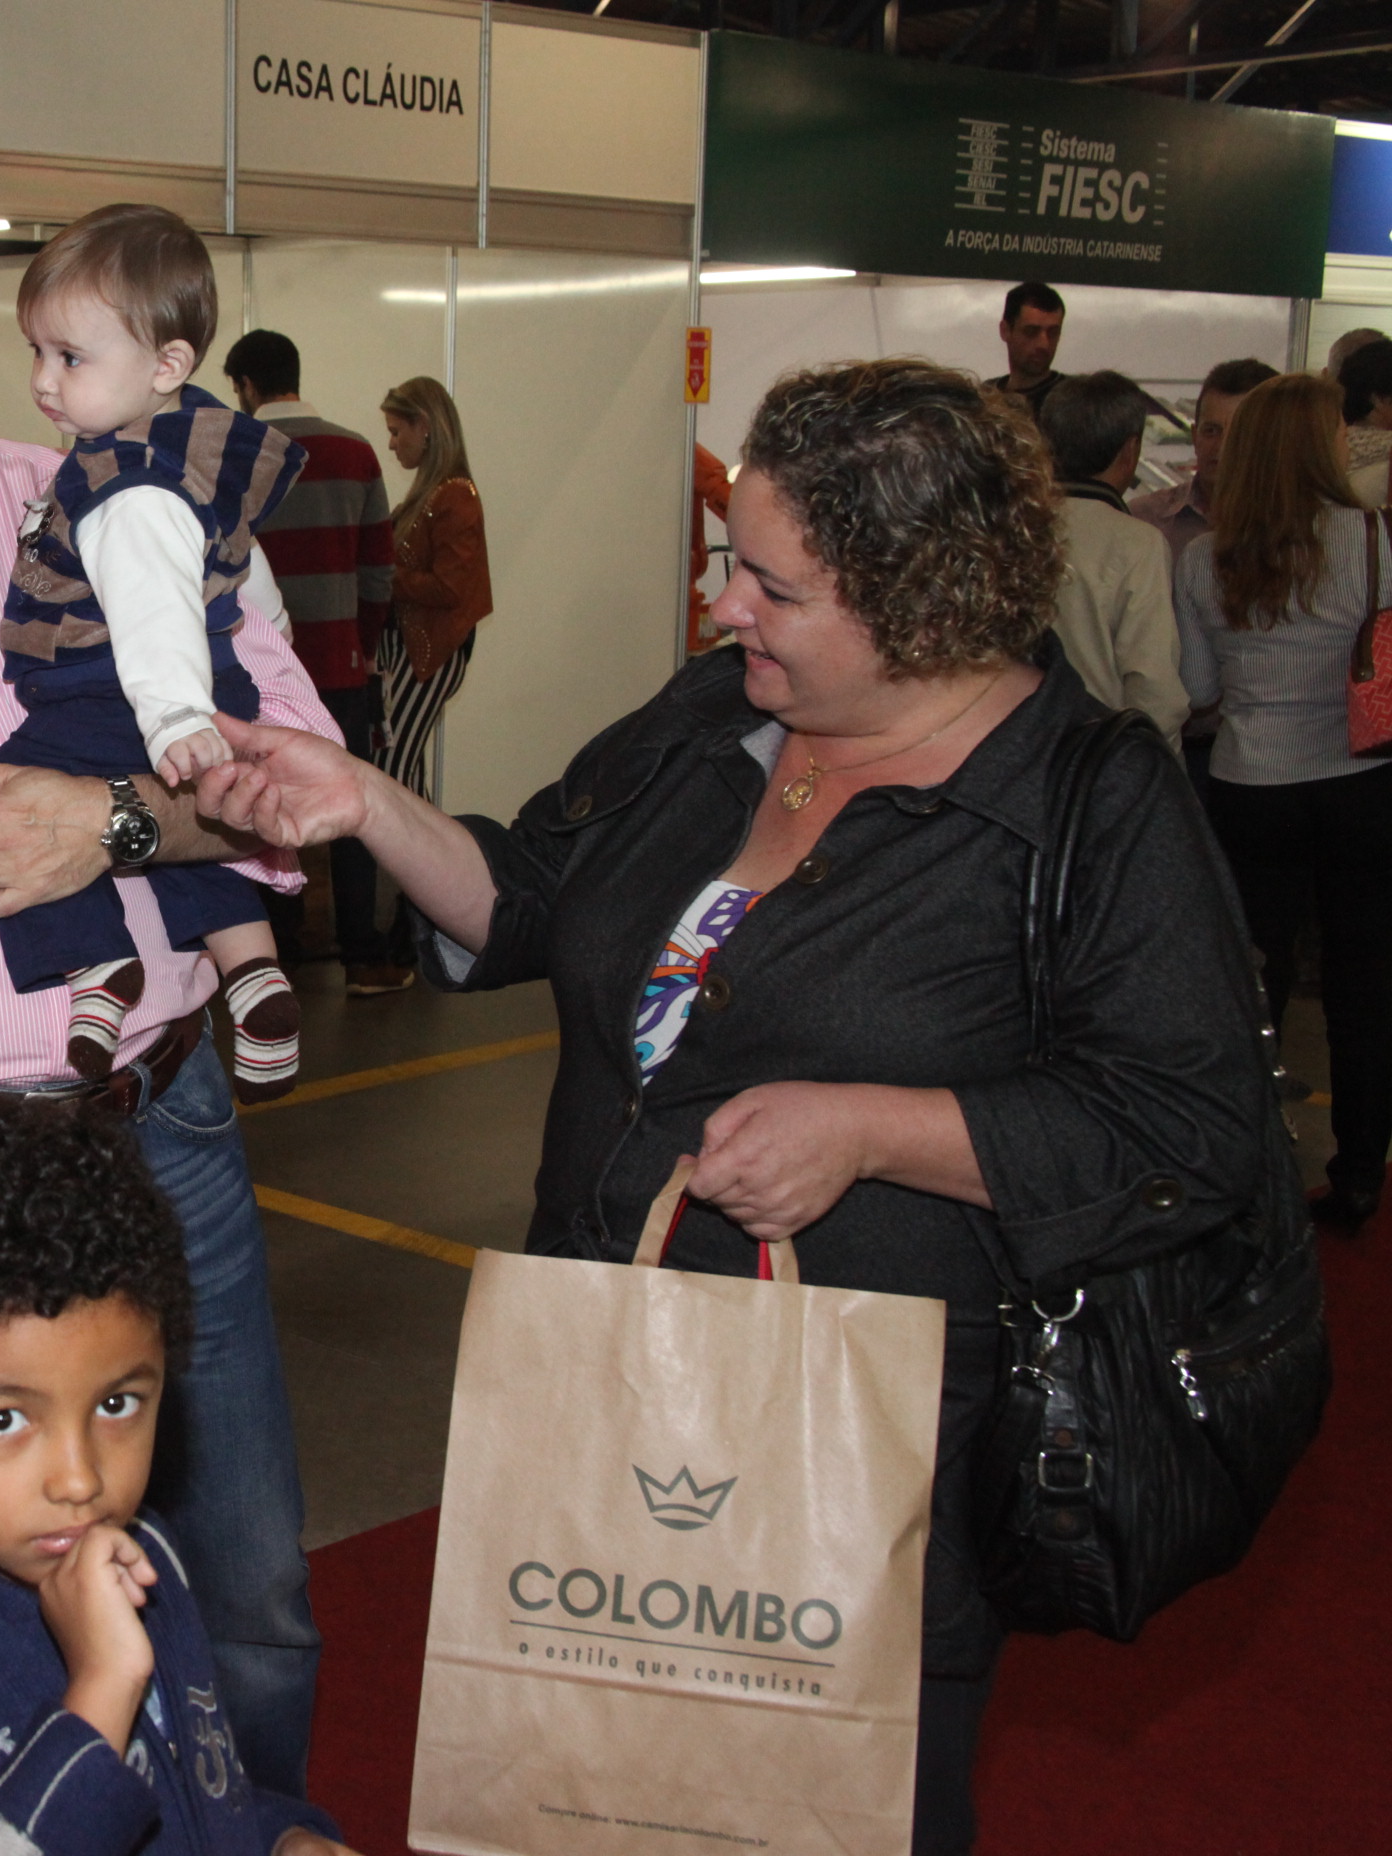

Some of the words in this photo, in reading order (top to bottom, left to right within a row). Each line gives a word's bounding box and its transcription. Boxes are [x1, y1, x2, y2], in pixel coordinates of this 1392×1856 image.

[253, 54, 335, 102] CASA
[342, 62, 464, 116] CLÁUDIA
[970, 122, 998, 140] FIESC
[1039, 128, 1116, 163] Sistema
[967, 174, 996, 190] SENAI
[972, 158, 994, 173] SESI
[1036, 162, 1150, 224] FIESC
[945, 229, 955, 247] A
[957, 230, 1001, 254] FORÇA
[1002, 234, 1019, 250] DA
[1022, 232, 1084, 255] INDÚSTRIA
[1086, 239, 1163, 262] CATARINENSE
[509, 1561, 843, 1650] COLOMBO
[519, 1642, 529, 1655] o
[545, 1640, 619, 1668] estilo
[635, 1658, 677, 1678] que
[694, 1666, 822, 1696] conquista
[538, 1803, 577, 1818] Compre
